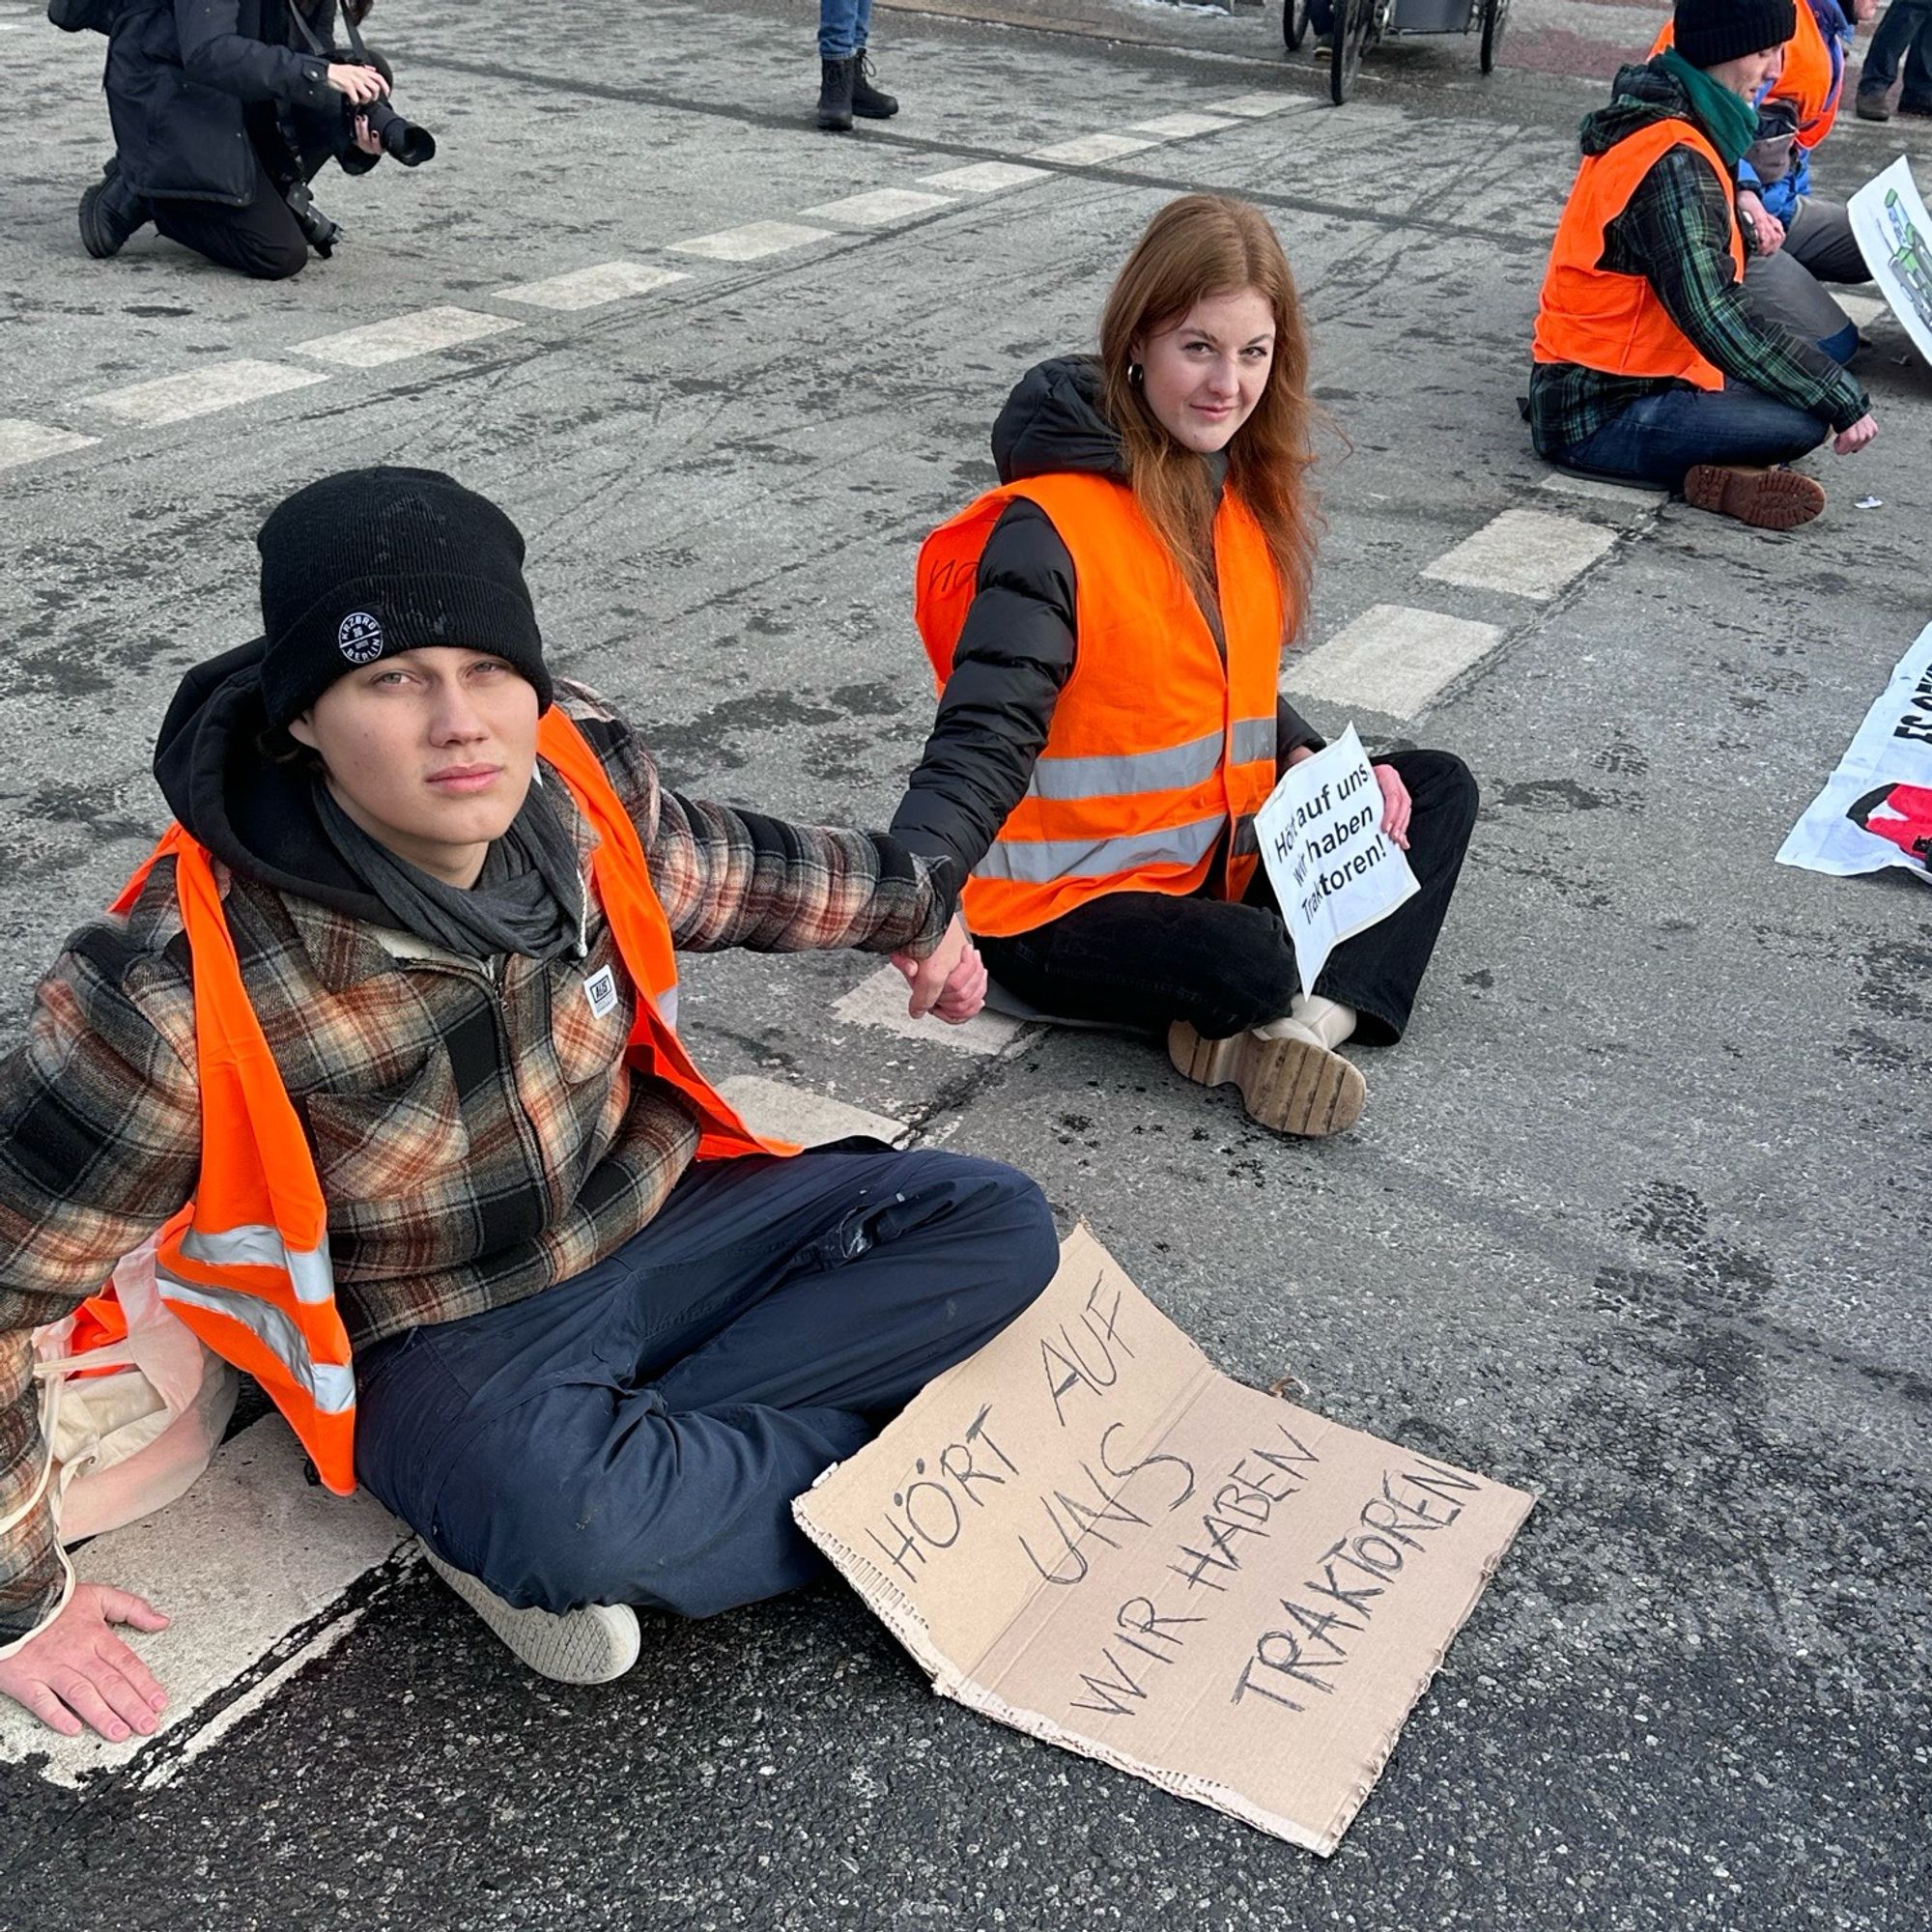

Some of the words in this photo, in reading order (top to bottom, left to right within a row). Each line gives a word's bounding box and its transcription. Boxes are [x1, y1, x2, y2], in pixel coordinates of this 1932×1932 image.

[347, 638, 380, 661] BERLIN
[1274, 815, 1298, 864] Hört
[1297, 783, 1330, 828] auf
[1293, 853, 1308, 888] wir
[1306, 805, 1374, 864] haben
[1301, 834, 1387, 924] Traktoren!
[865, 1404, 1020, 1582] HÖRT
[1039, 1269, 1136, 1427] AUF
[1019, 1421, 1195, 1584] UNS
[1070, 1597, 1208, 1716] WIR
[1166, 1424, 1320, 1591] HABEN
[1230, 1458, 1483, 1712] TRAKTOREN
